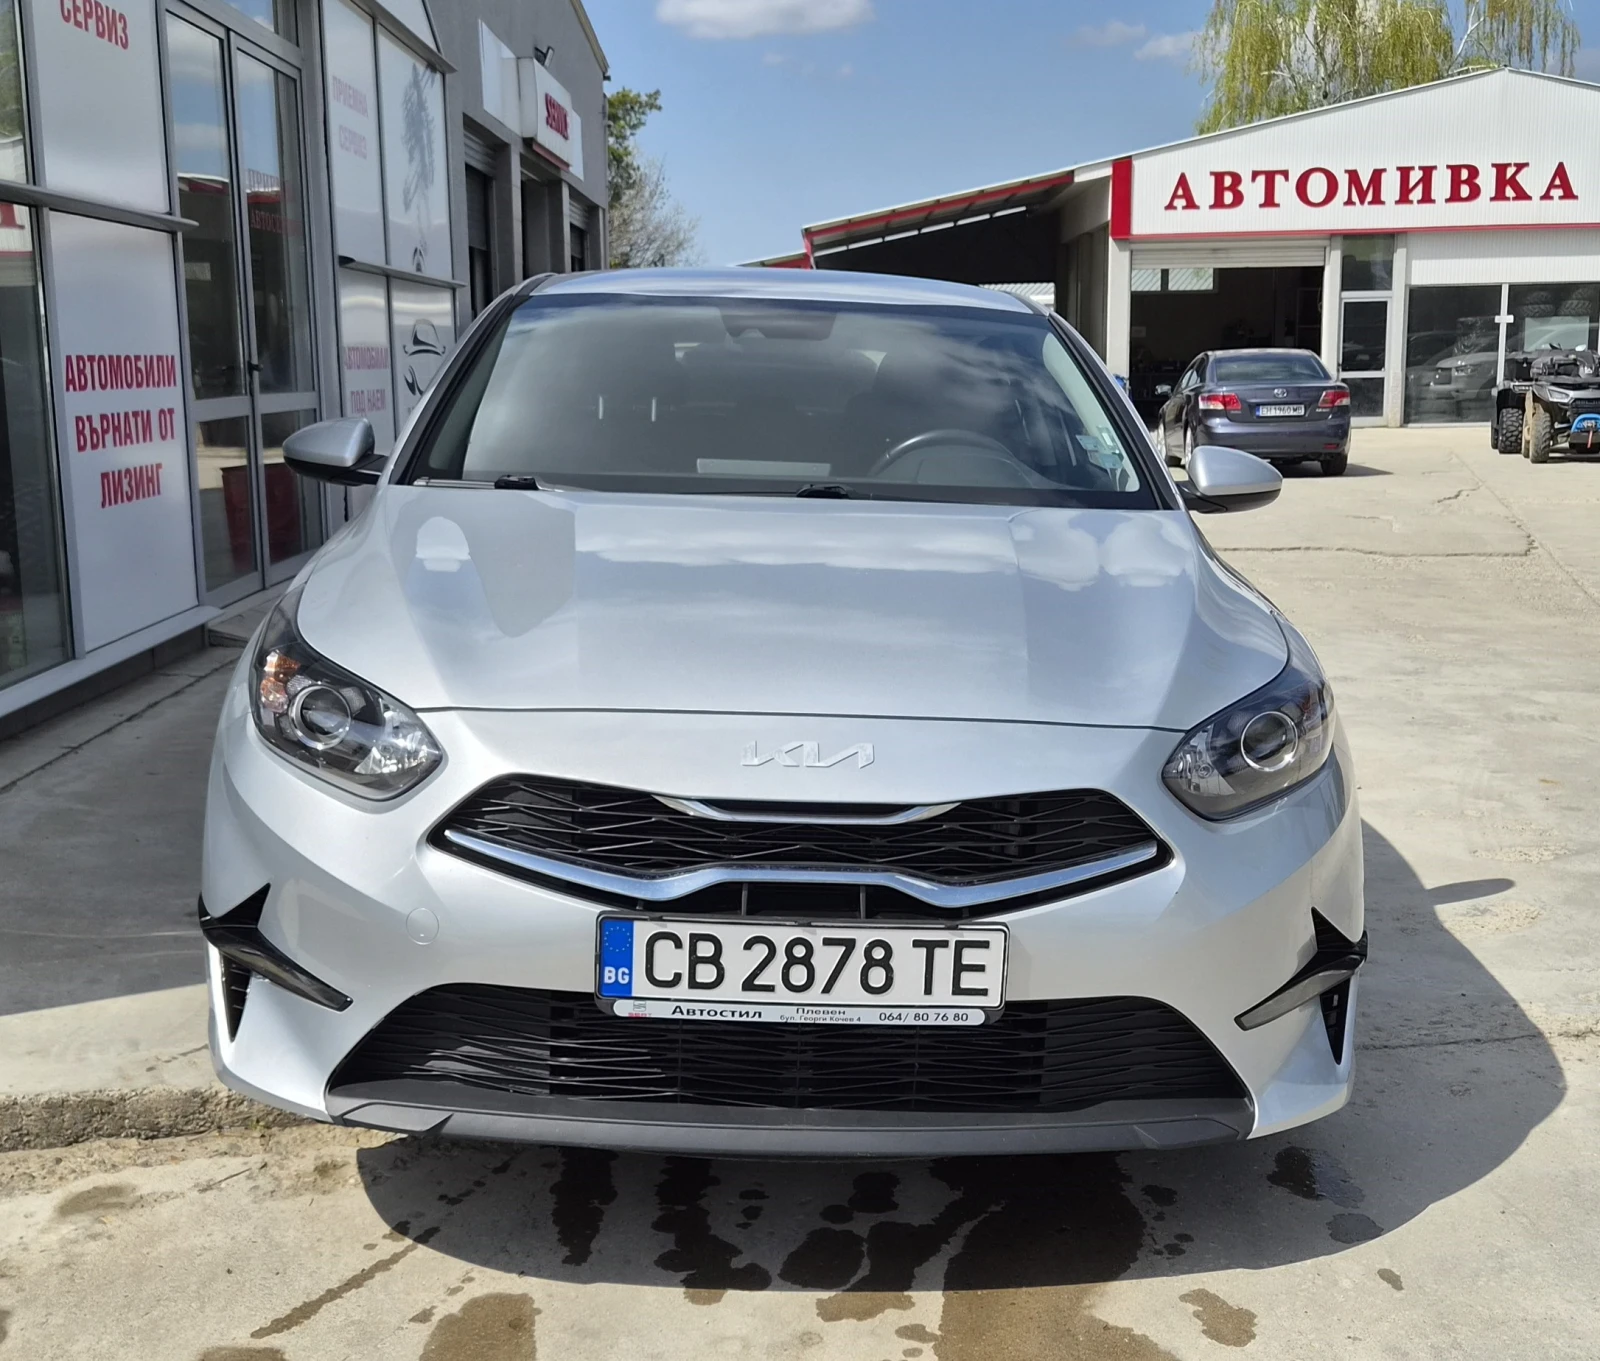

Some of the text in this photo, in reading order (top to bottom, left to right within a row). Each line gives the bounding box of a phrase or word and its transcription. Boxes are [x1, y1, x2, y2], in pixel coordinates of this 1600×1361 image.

[60, 0, 129, 50] СЕРВИЗ
[1164, 161, 1579, 211] АВТОМИВКА
[65, 354, 177, 392] АВТОМОБИЛИ
[75, 408, 175, 453] ВЪРНАТИ ОТ
[100, 463, 163, 509] ЛИЗИНГ
[741, 740, 875, 769] KIA
[604, 966, 630, 985] BG
[645, 931, 990, 997] CB 2878 TE
[671, 1005, 763, 1020] Автостил
[795, 1007, 847, 1016] Плевен
[878, 1012, 969, 1023] 064/ 80 76 80
